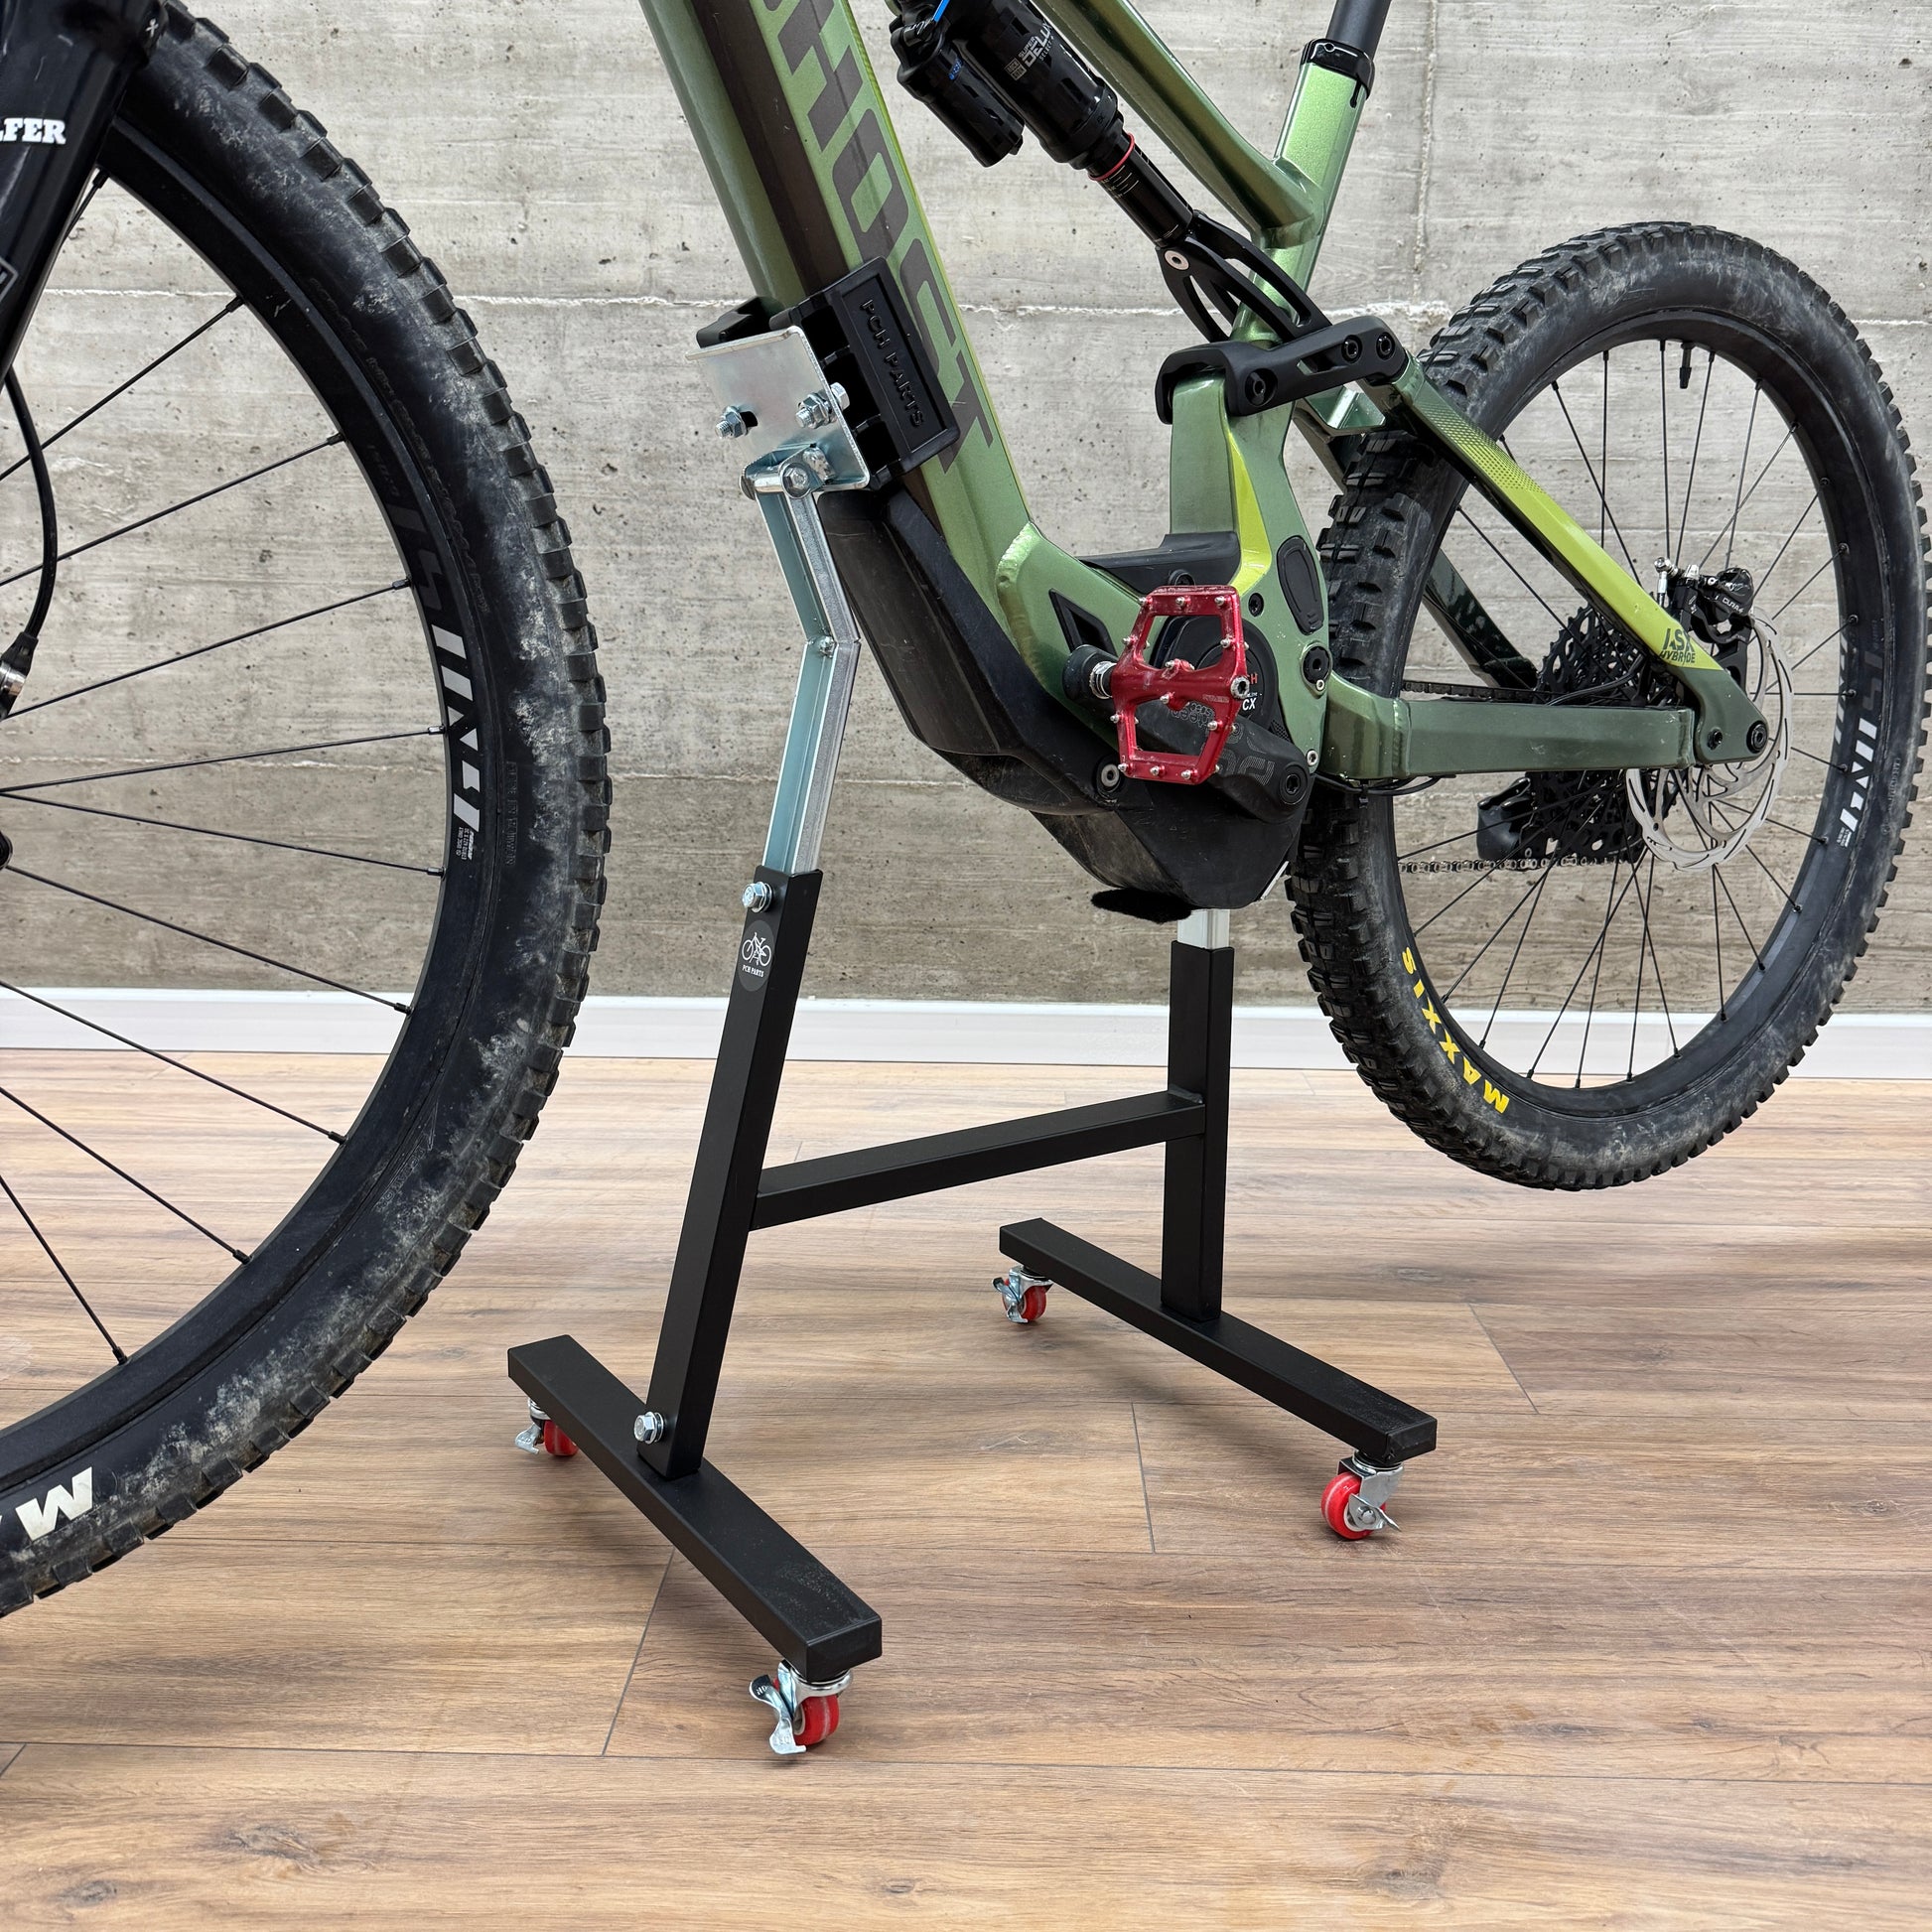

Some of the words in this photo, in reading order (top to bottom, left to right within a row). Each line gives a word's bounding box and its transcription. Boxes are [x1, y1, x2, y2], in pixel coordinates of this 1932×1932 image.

[1023, 19, 1053, 68] DELUX
[0, 117, 67, 145] FER
[763, 0, 994, 474] HOST
[860, 299, 892, 349] PCH
[885, 351, 924, 427] PARTS
[1242, 697, 1257, 711] CX
[752, 967, 764, 978] PARTS
[1402, 946, 1510, 1114] MAXXIS
[0, 1465, 93, 1542] M
